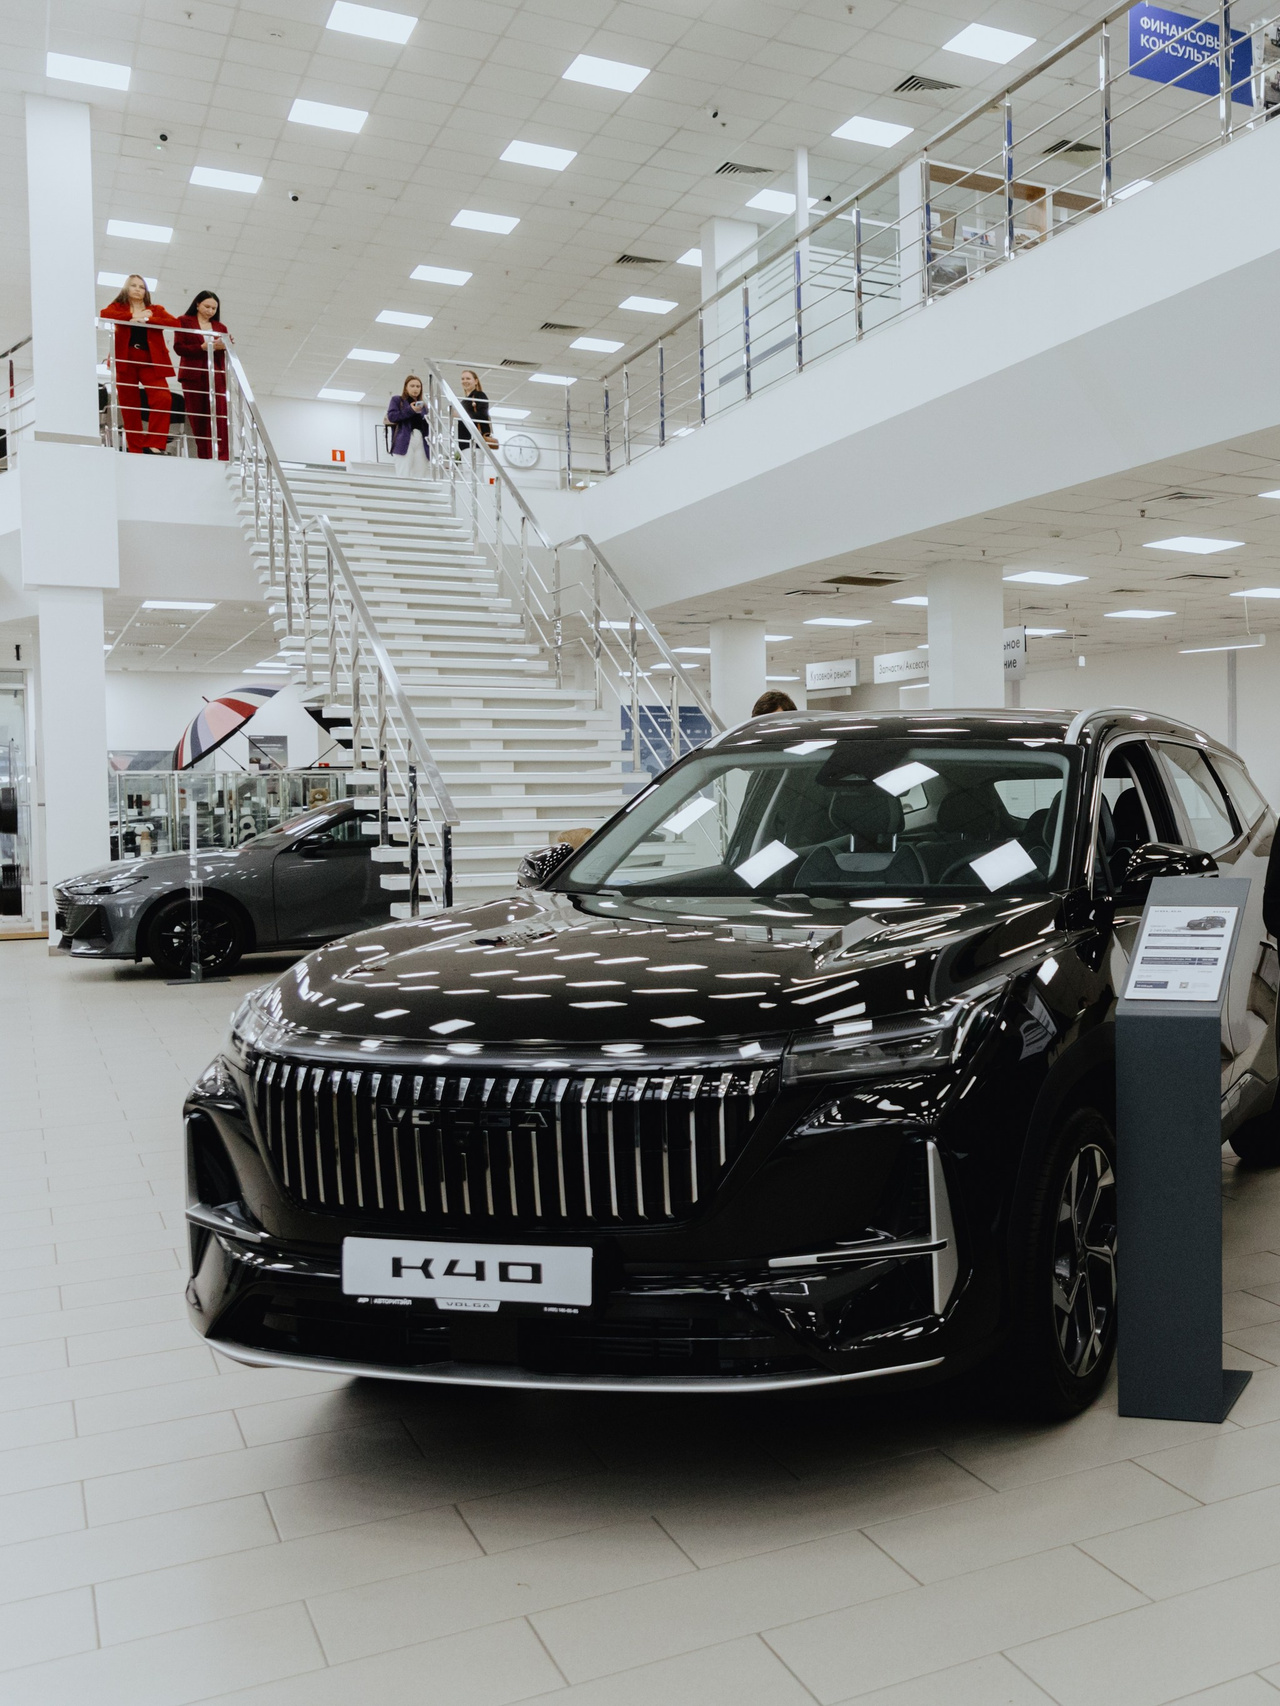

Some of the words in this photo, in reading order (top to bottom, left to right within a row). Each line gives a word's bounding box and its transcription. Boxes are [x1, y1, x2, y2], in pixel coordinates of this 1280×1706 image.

[1140, 34, 1235, 70] КОНСУЛЬТАТ
[810, 668, 833, 684] Кузовной
[834, 670, 852, 683] ремонт
[392, 1257, 543, 1284] K40
